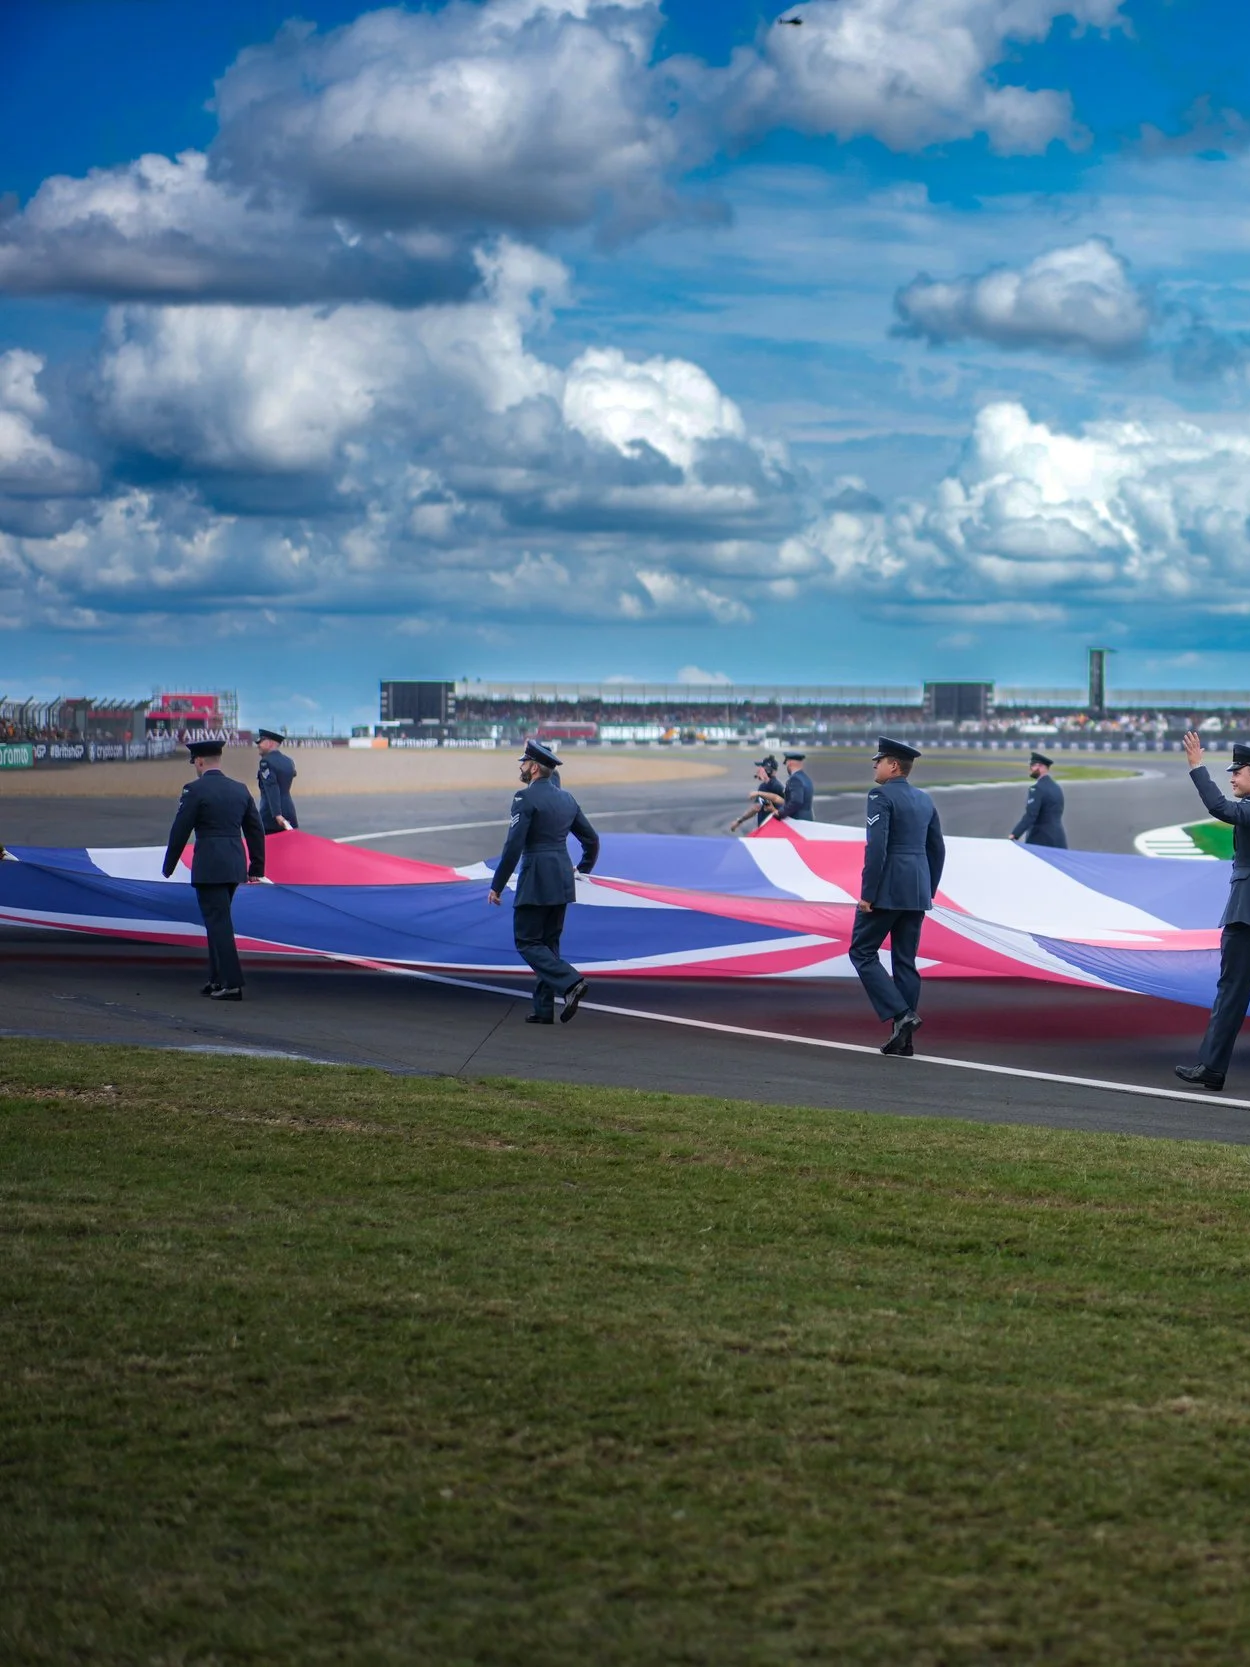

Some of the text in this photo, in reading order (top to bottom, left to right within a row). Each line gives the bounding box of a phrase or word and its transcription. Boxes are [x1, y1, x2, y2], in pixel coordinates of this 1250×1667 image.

[146, 728, 240, 741] ATAR AIRWAYS
[50, 744, 84, 758] #BritishGP
